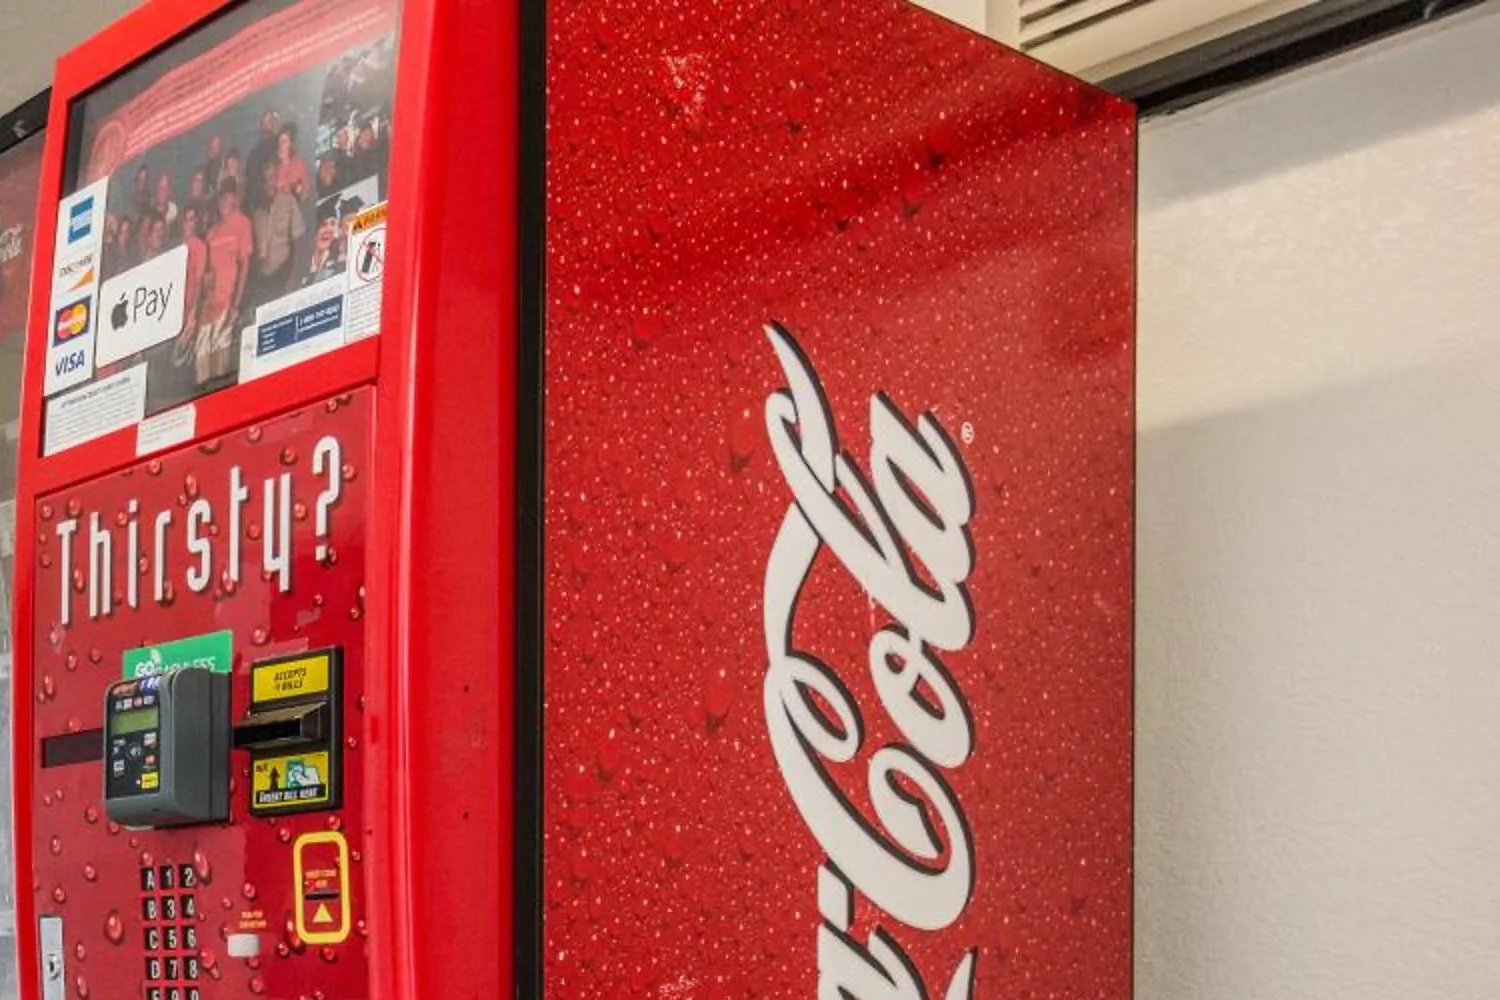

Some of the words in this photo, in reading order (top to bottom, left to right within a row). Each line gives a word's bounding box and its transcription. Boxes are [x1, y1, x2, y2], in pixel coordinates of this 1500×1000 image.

[133, 283, 173, 323] Pay
[54, 349, 86, 377] VISA
[56, 435, 342, 625] Thirsty?
[146, 869, 155, 889] A
[166, 867, 173, 887] 1
[184, 866, 194, 887] 2
[167, 899, 176, 919] 3
[186, 897, 195, 917] 4
[149, 930, 159, 950] C
[168, 929, 177, 949] 5
[187, 928, 197, 948] 6
[169, 959, 178, 979] 7
[189, 958, 198, 979] 8
